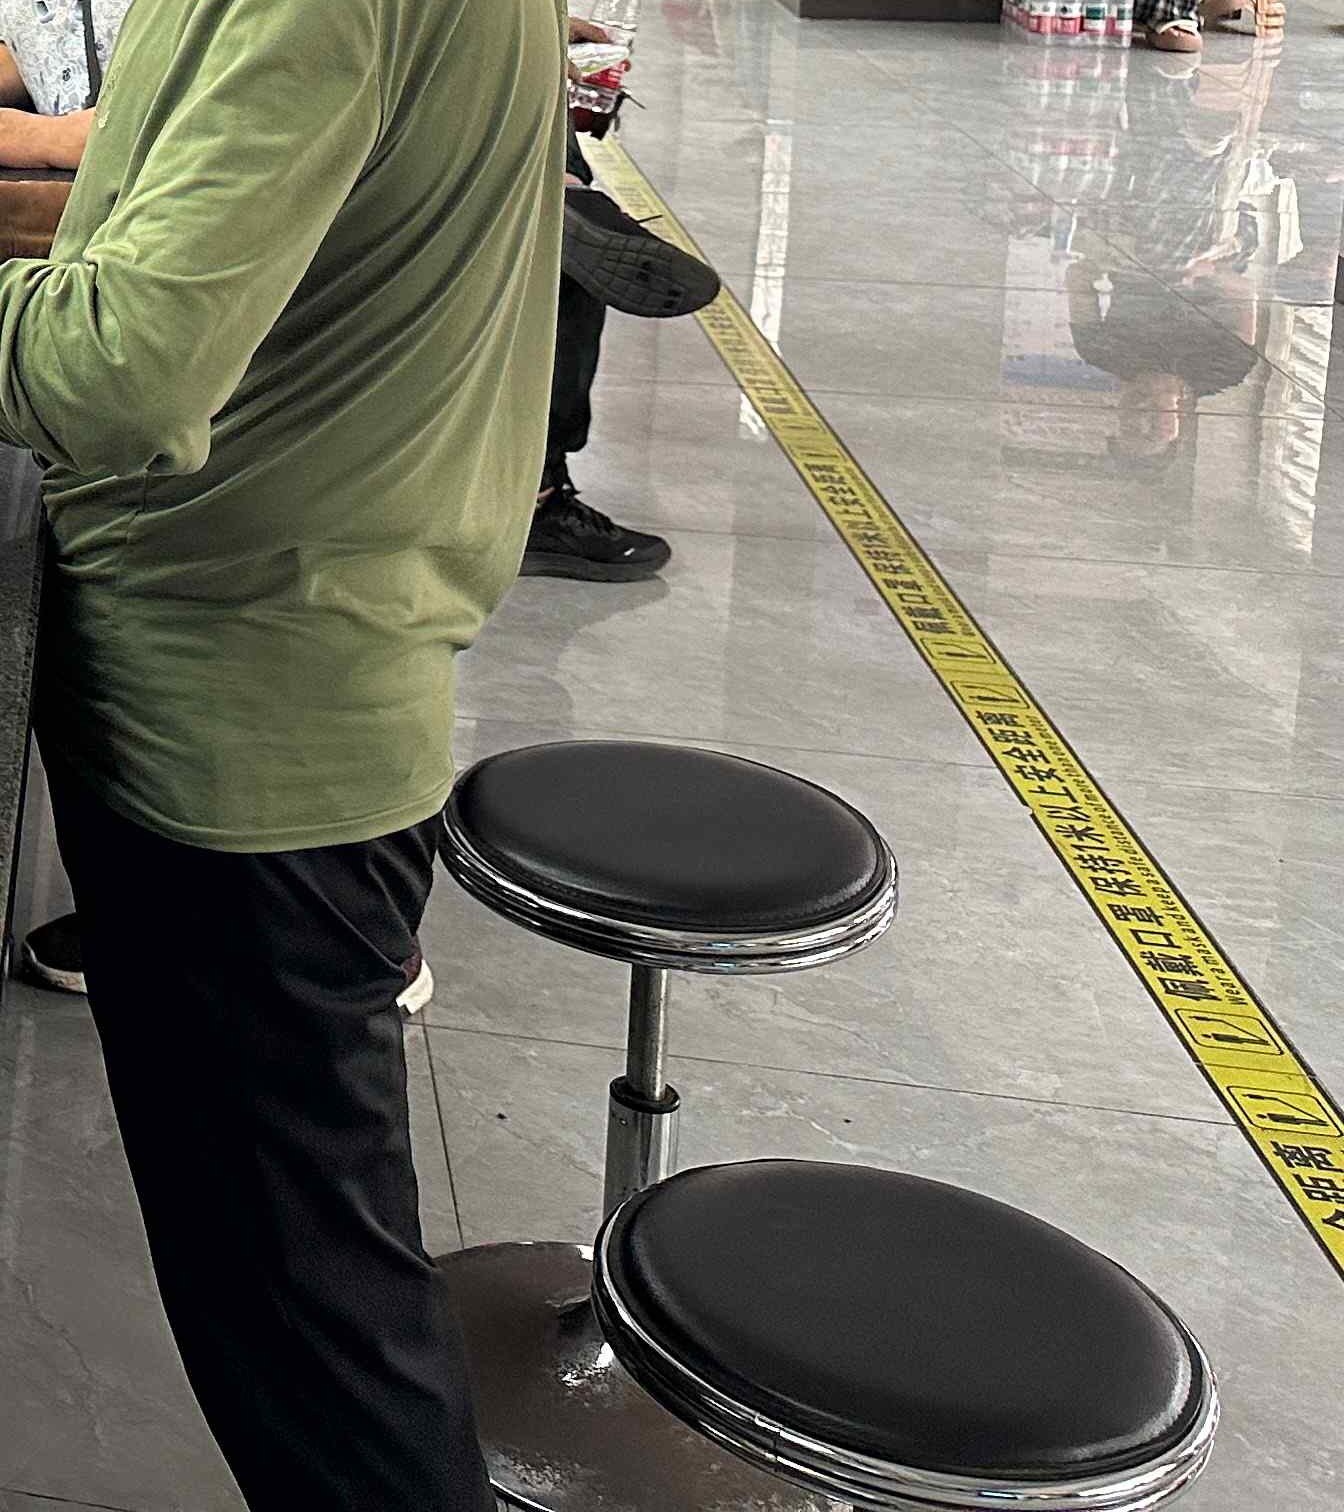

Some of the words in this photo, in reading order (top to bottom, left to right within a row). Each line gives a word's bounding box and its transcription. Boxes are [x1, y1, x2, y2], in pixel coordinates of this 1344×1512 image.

[975, 709, 1148, 897] 保持1米以上安全距离
[1106, 903, 1223, 1001] 佩戴口罩
